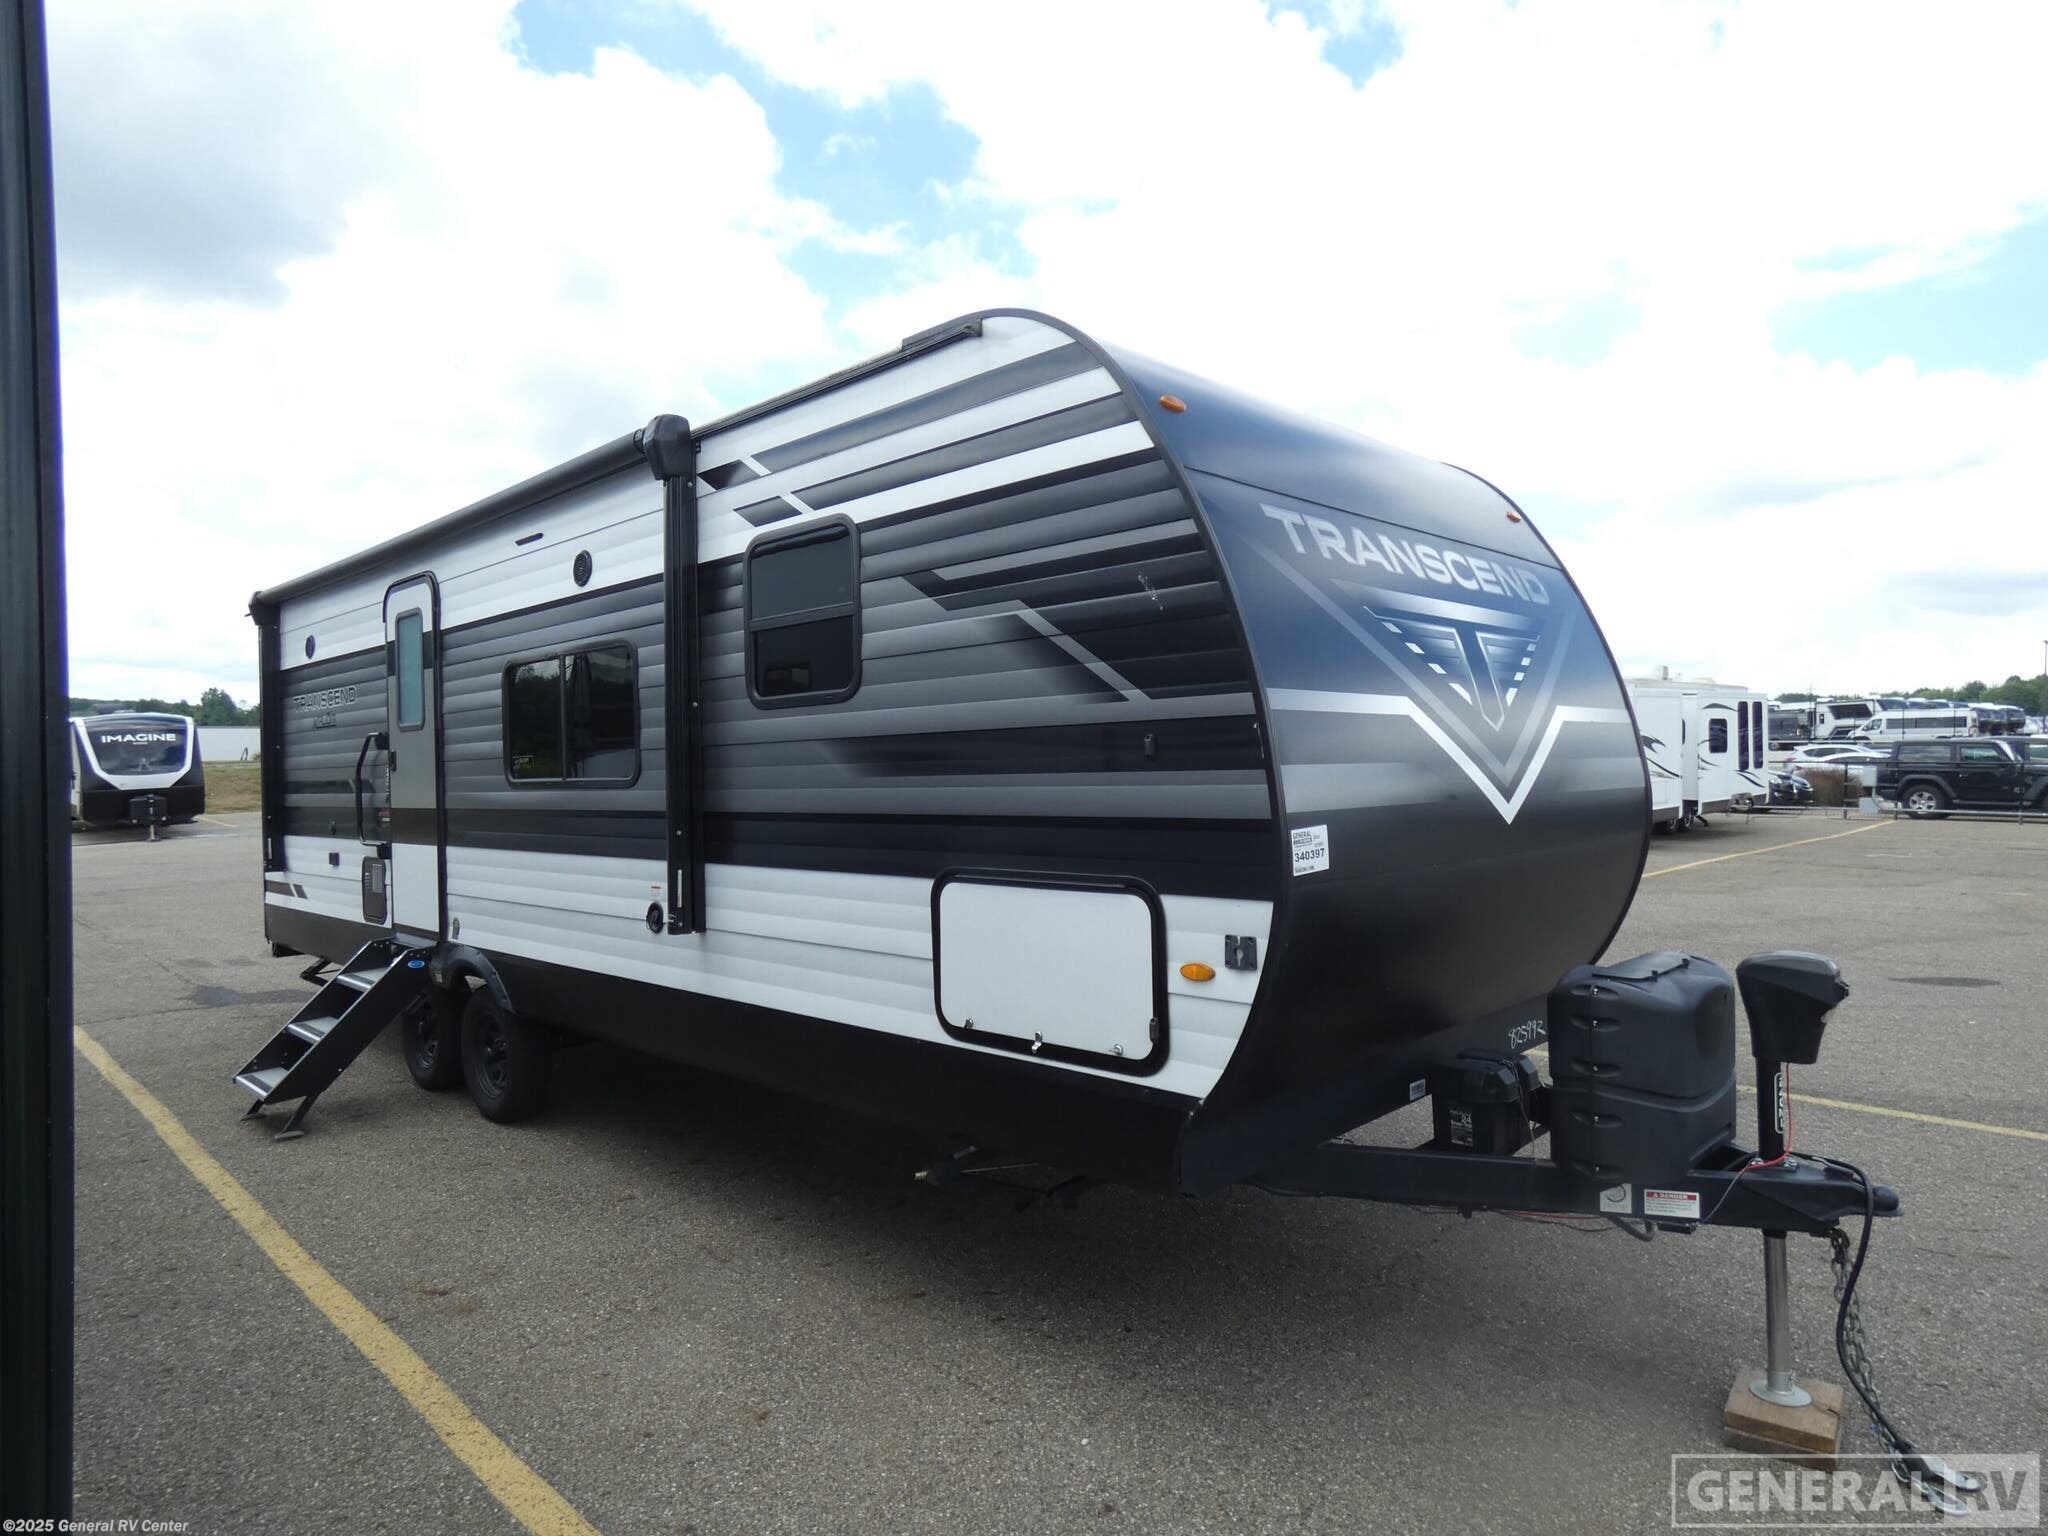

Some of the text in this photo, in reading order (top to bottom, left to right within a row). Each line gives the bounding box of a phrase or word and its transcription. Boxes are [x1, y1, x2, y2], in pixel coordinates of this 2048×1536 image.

[1259, 503, 1549, 605] TRANSCEND
[293, 685, 357, 713] TRANSCEND
[101, 733, 177, 743] IMAGINE
[1294, 848, 1325, 863] 340397
